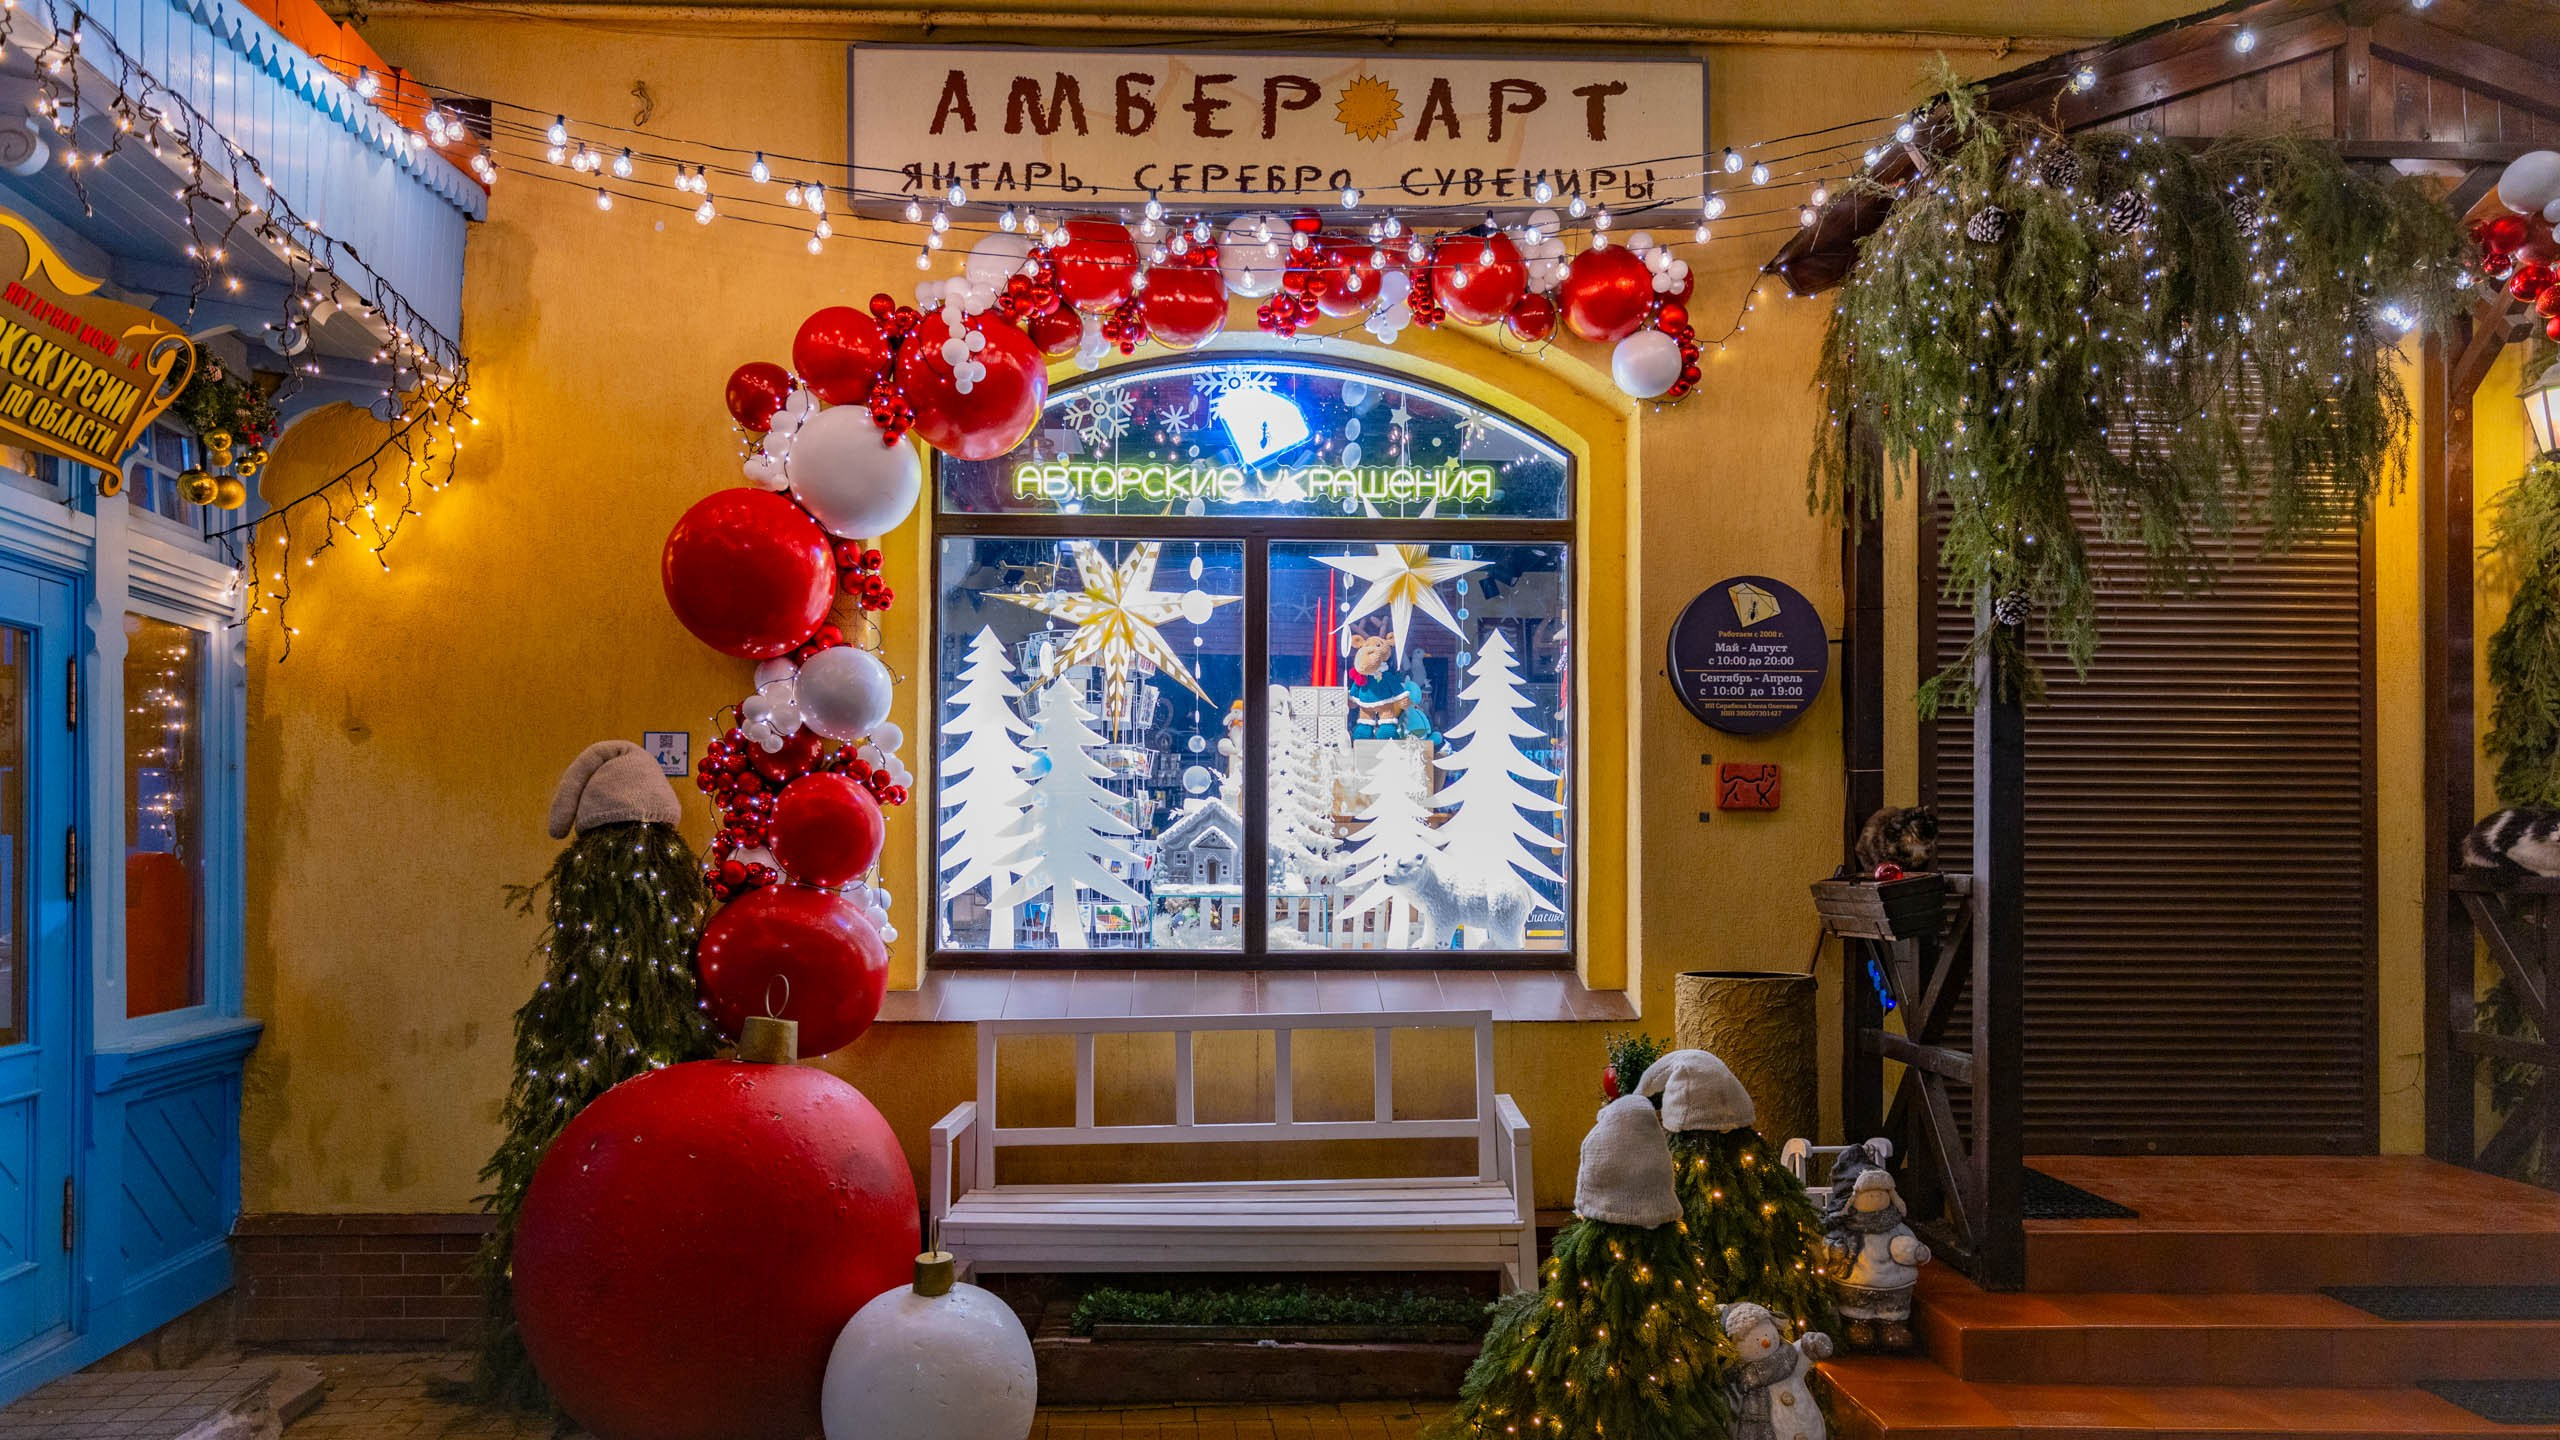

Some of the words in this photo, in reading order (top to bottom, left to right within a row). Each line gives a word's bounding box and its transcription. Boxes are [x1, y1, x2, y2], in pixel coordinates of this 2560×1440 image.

[929, 69, 1322, 140] АМБЕР
[1413, 77, 1629, 144] АРТ
[901, 161, 1099, 195] ЯНТАРЬ,
[1134, 163, 1365, 199] СЕРЕБРО,
[1400, 167, 1656, 201] СУВЕНИРЫ
[2, 281, 82, 335] ЯНТАРНАЯ
[0, 383, 34, 419] ПО
[28, 397, 118, 456] ОБЛАСТИ
[1715, 643, 1740, 652] Май
[1749, 643, 1788, 655] Август
[1717, 656, 1747, 665] 10:00
[1748, 658, 1762, 667] до
[1764, 656, 1794, 665] 20:00
[1700, 673, 1752, 684] Сентябрь
[1762, 673, 1803, 684] Апрель
[1713, 687, 1745, 696] 10:00
[1750, 688, 1765, 697] до
[1771, 687, 1803, 696] 19:00
